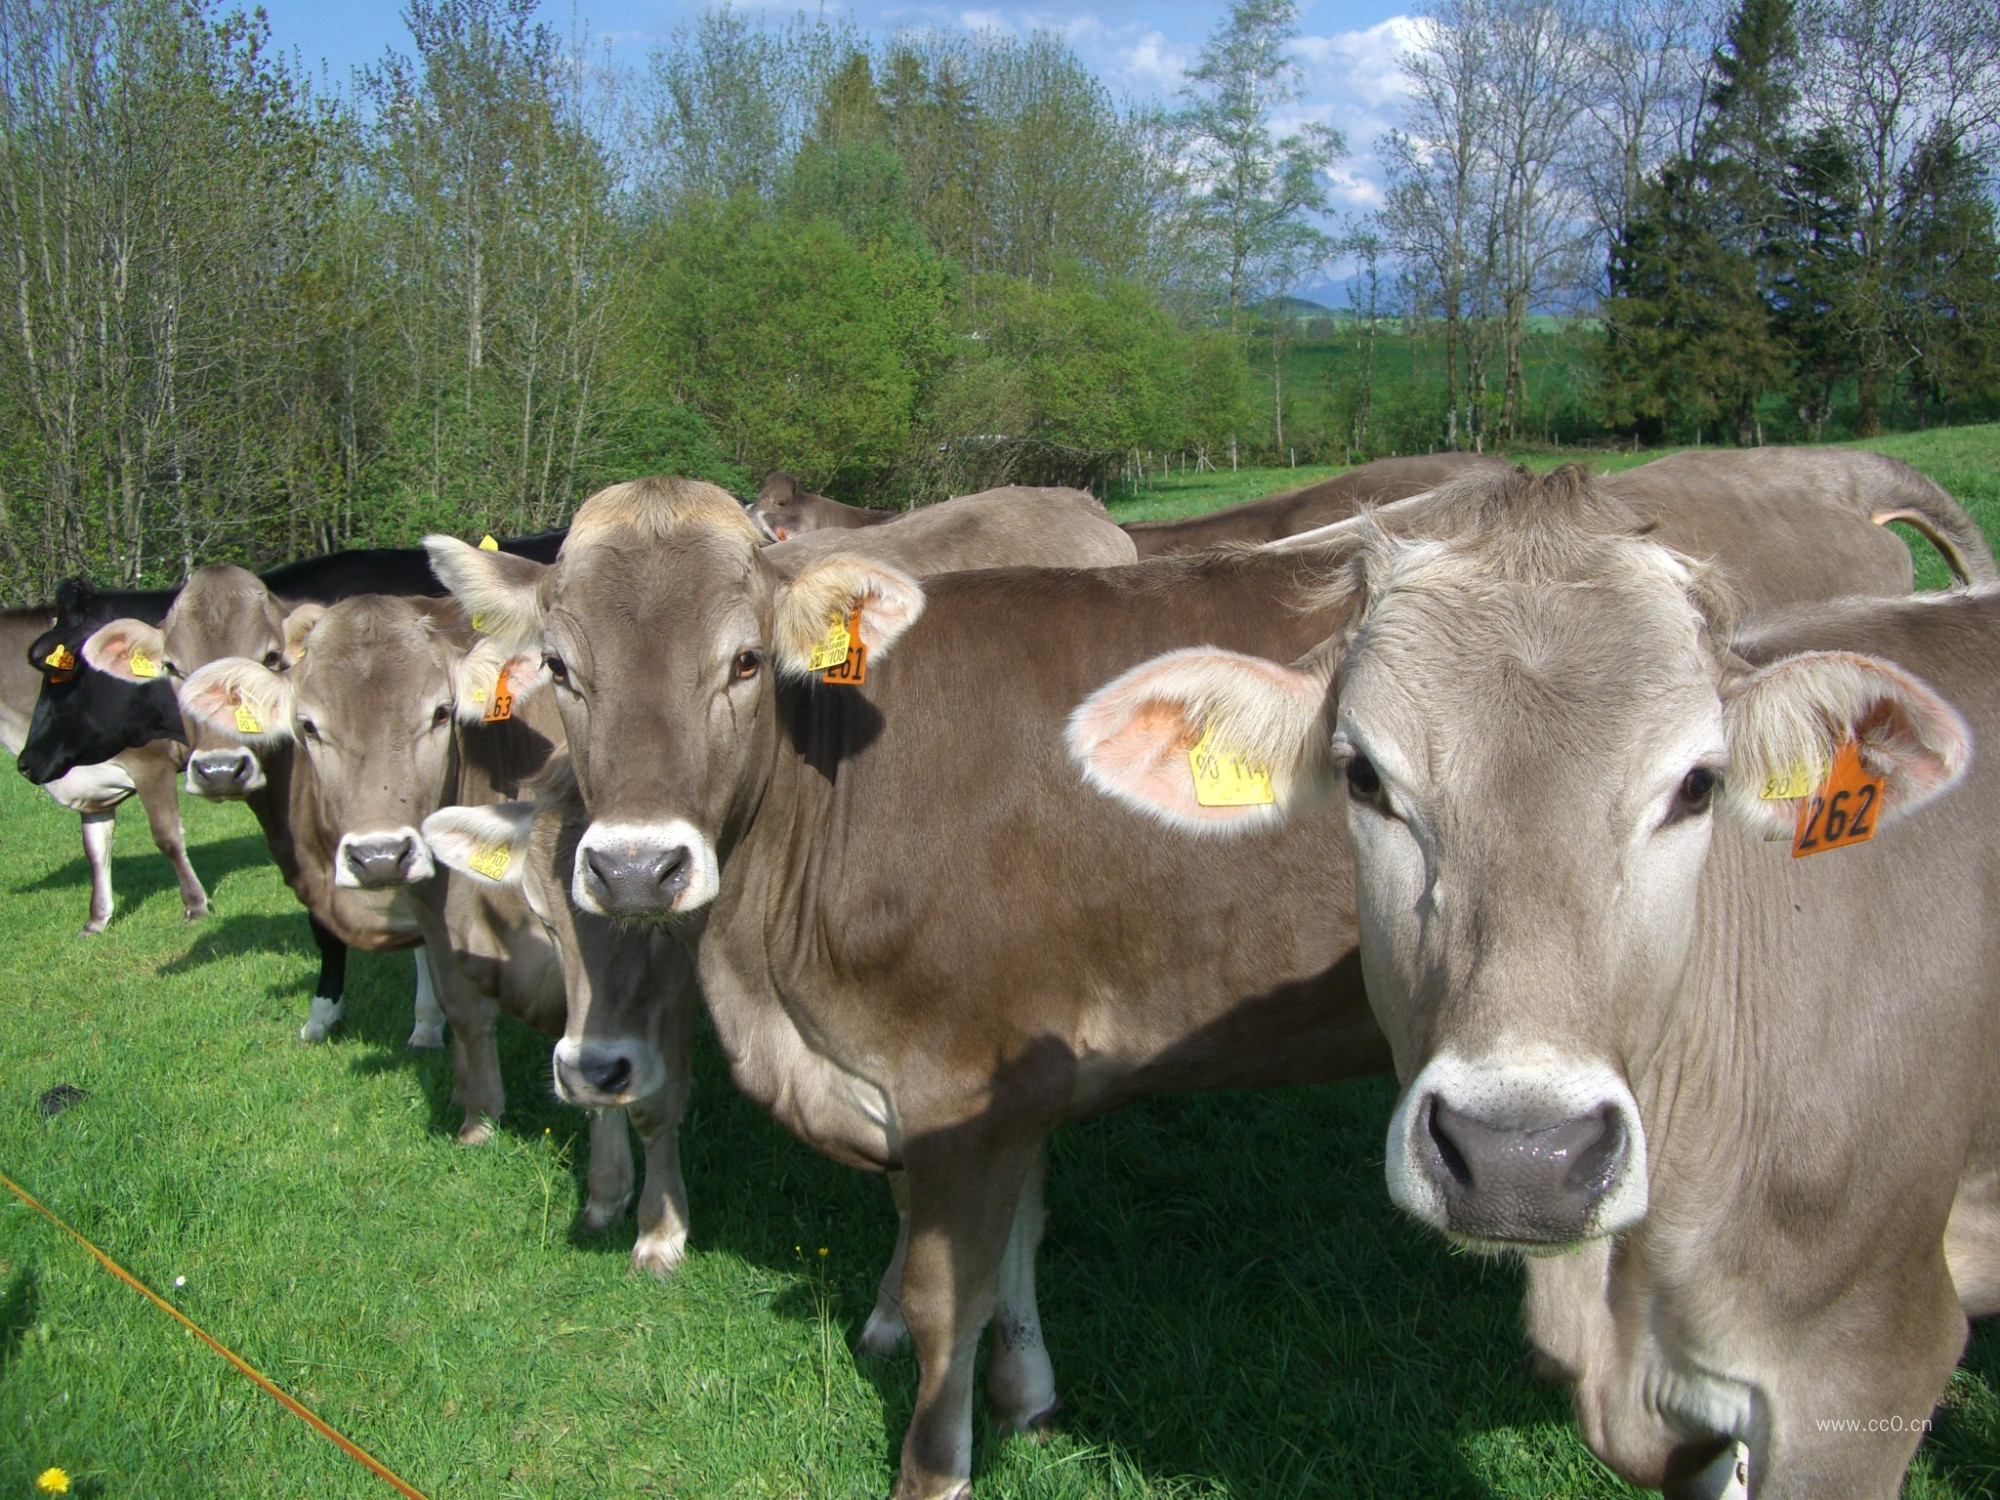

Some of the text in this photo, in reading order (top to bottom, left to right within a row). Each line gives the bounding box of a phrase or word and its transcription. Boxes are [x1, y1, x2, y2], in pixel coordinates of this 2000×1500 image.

[829, 647, 846, 664] 108
[1798, 783, 1877, 851] 262
[491, 853, 509, 868] 107
